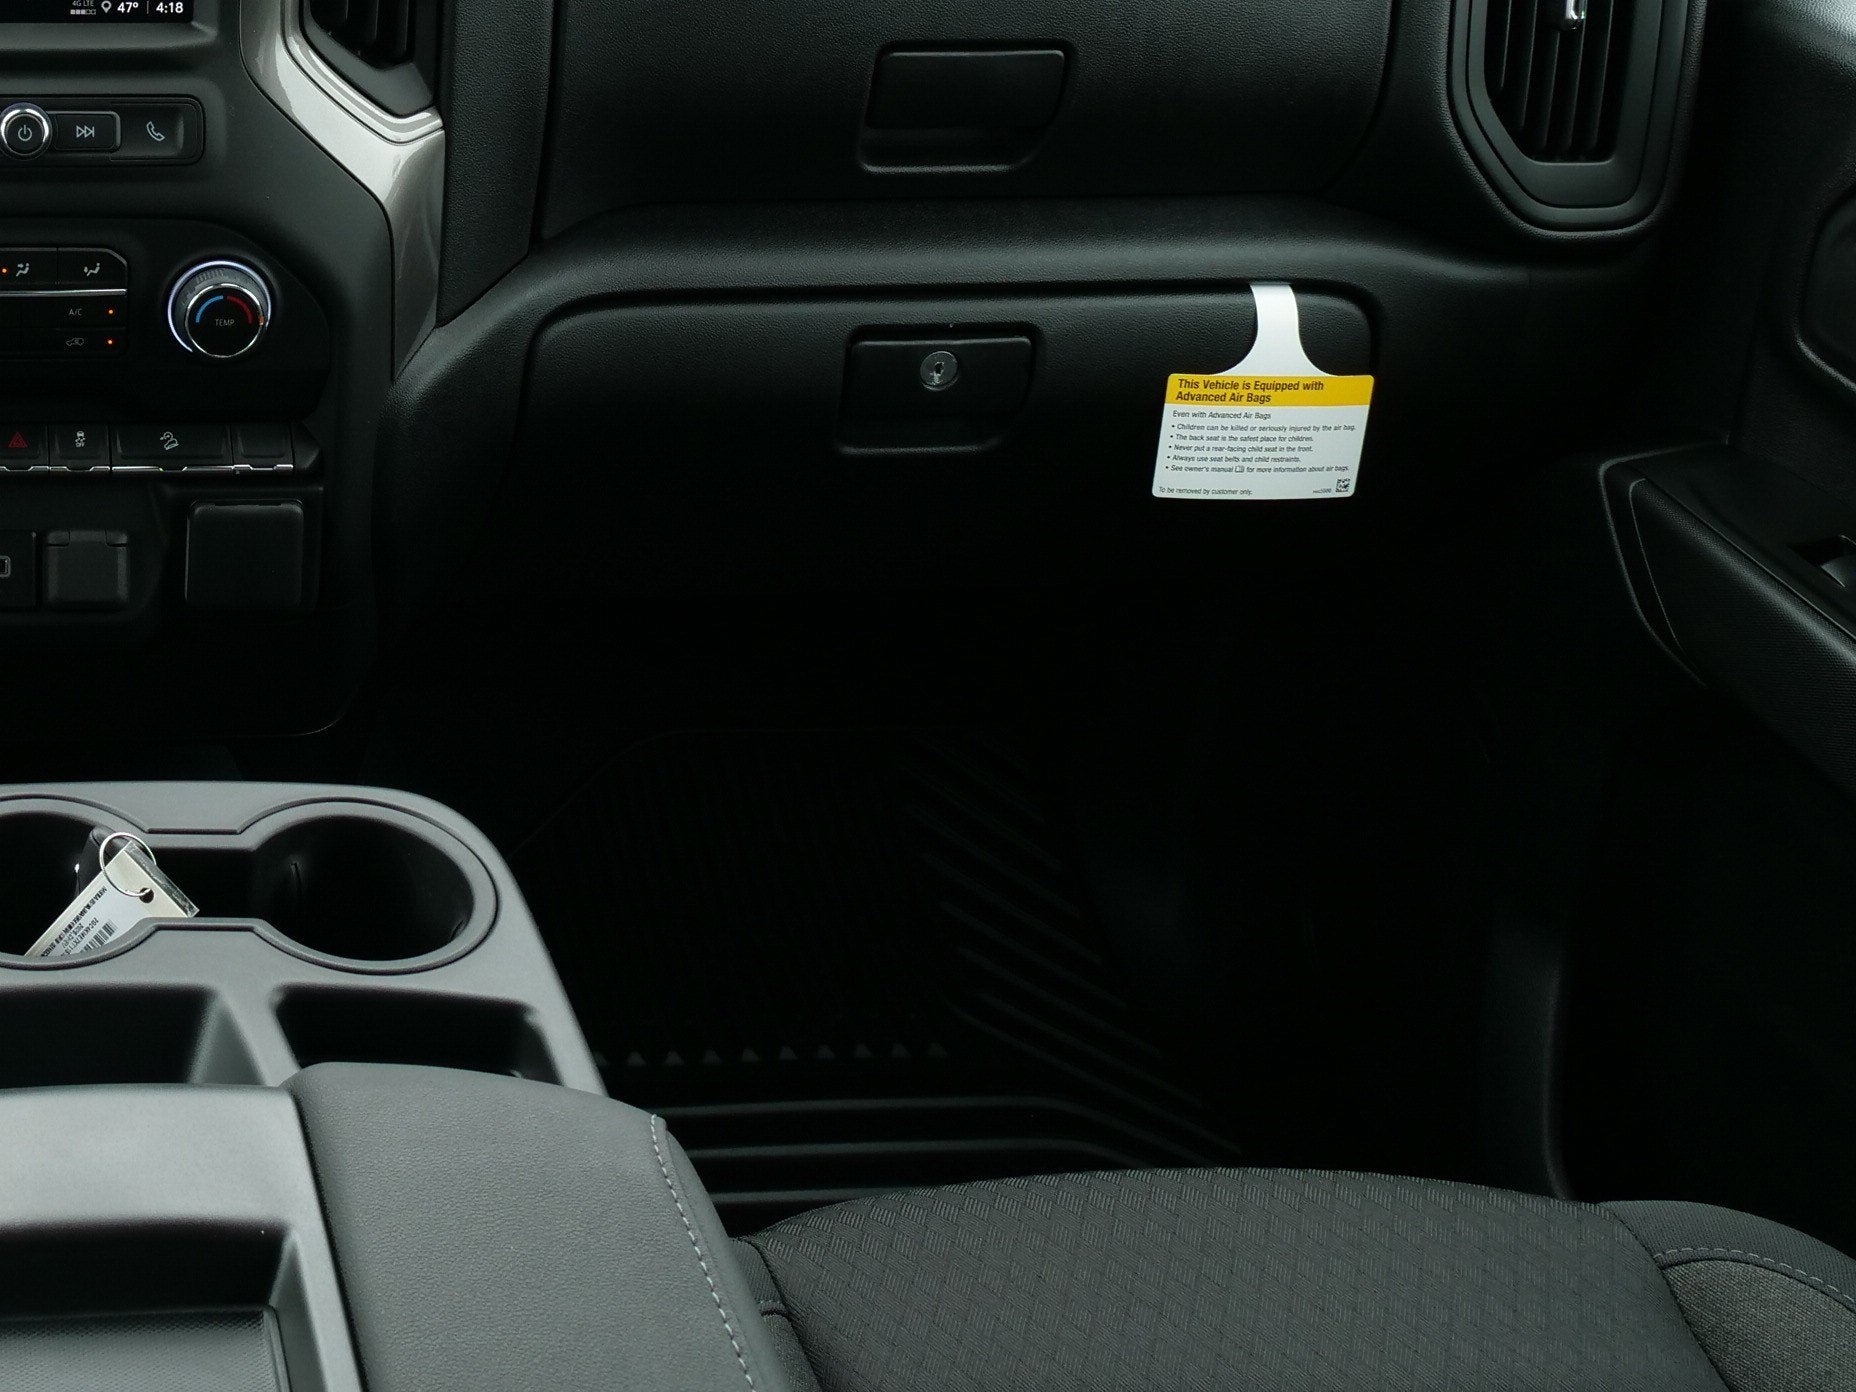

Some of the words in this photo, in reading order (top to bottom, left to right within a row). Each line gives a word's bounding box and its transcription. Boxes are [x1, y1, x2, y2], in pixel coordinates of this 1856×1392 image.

[117, 2, 139, 14] 47°
[156, 2, 184, 14] 4:18
[68, 308, 83, 317] A/C
[214, 319, 235, 327] TEMP
[1178, 379, 1199, 390] This
[1202, 379, 1240, 390] Vehicle
[1242, 380, 1251, 391] is
[1254, 380, 1300, 393] Equipped
[1302, 380, 1324, 391] with
[1175, 391, 1226, 402] Advanced
[1228, 392, 1244, 402] Air
[1246, 393, 1272, 405] Bags
[1172, 410, 1190, 418] Even
[1208, 411, 1242, 419] Advanced
[1254, 412, 1272, 420] Bags
[1258, 425, 1287, 433] seriously
[1289, 425, 1312, 433] injured
[1312, 425, 1320, 433] by
[1259, 435, 1277, 443] place
[1212, 445, 1247, 453] rear-facing
[1172, 454, 1196, 462] Always
[1170, 464, 1183, 472] See
[1308, 465, 1325, 473] about
[1203, 488, 1210, 496] by
